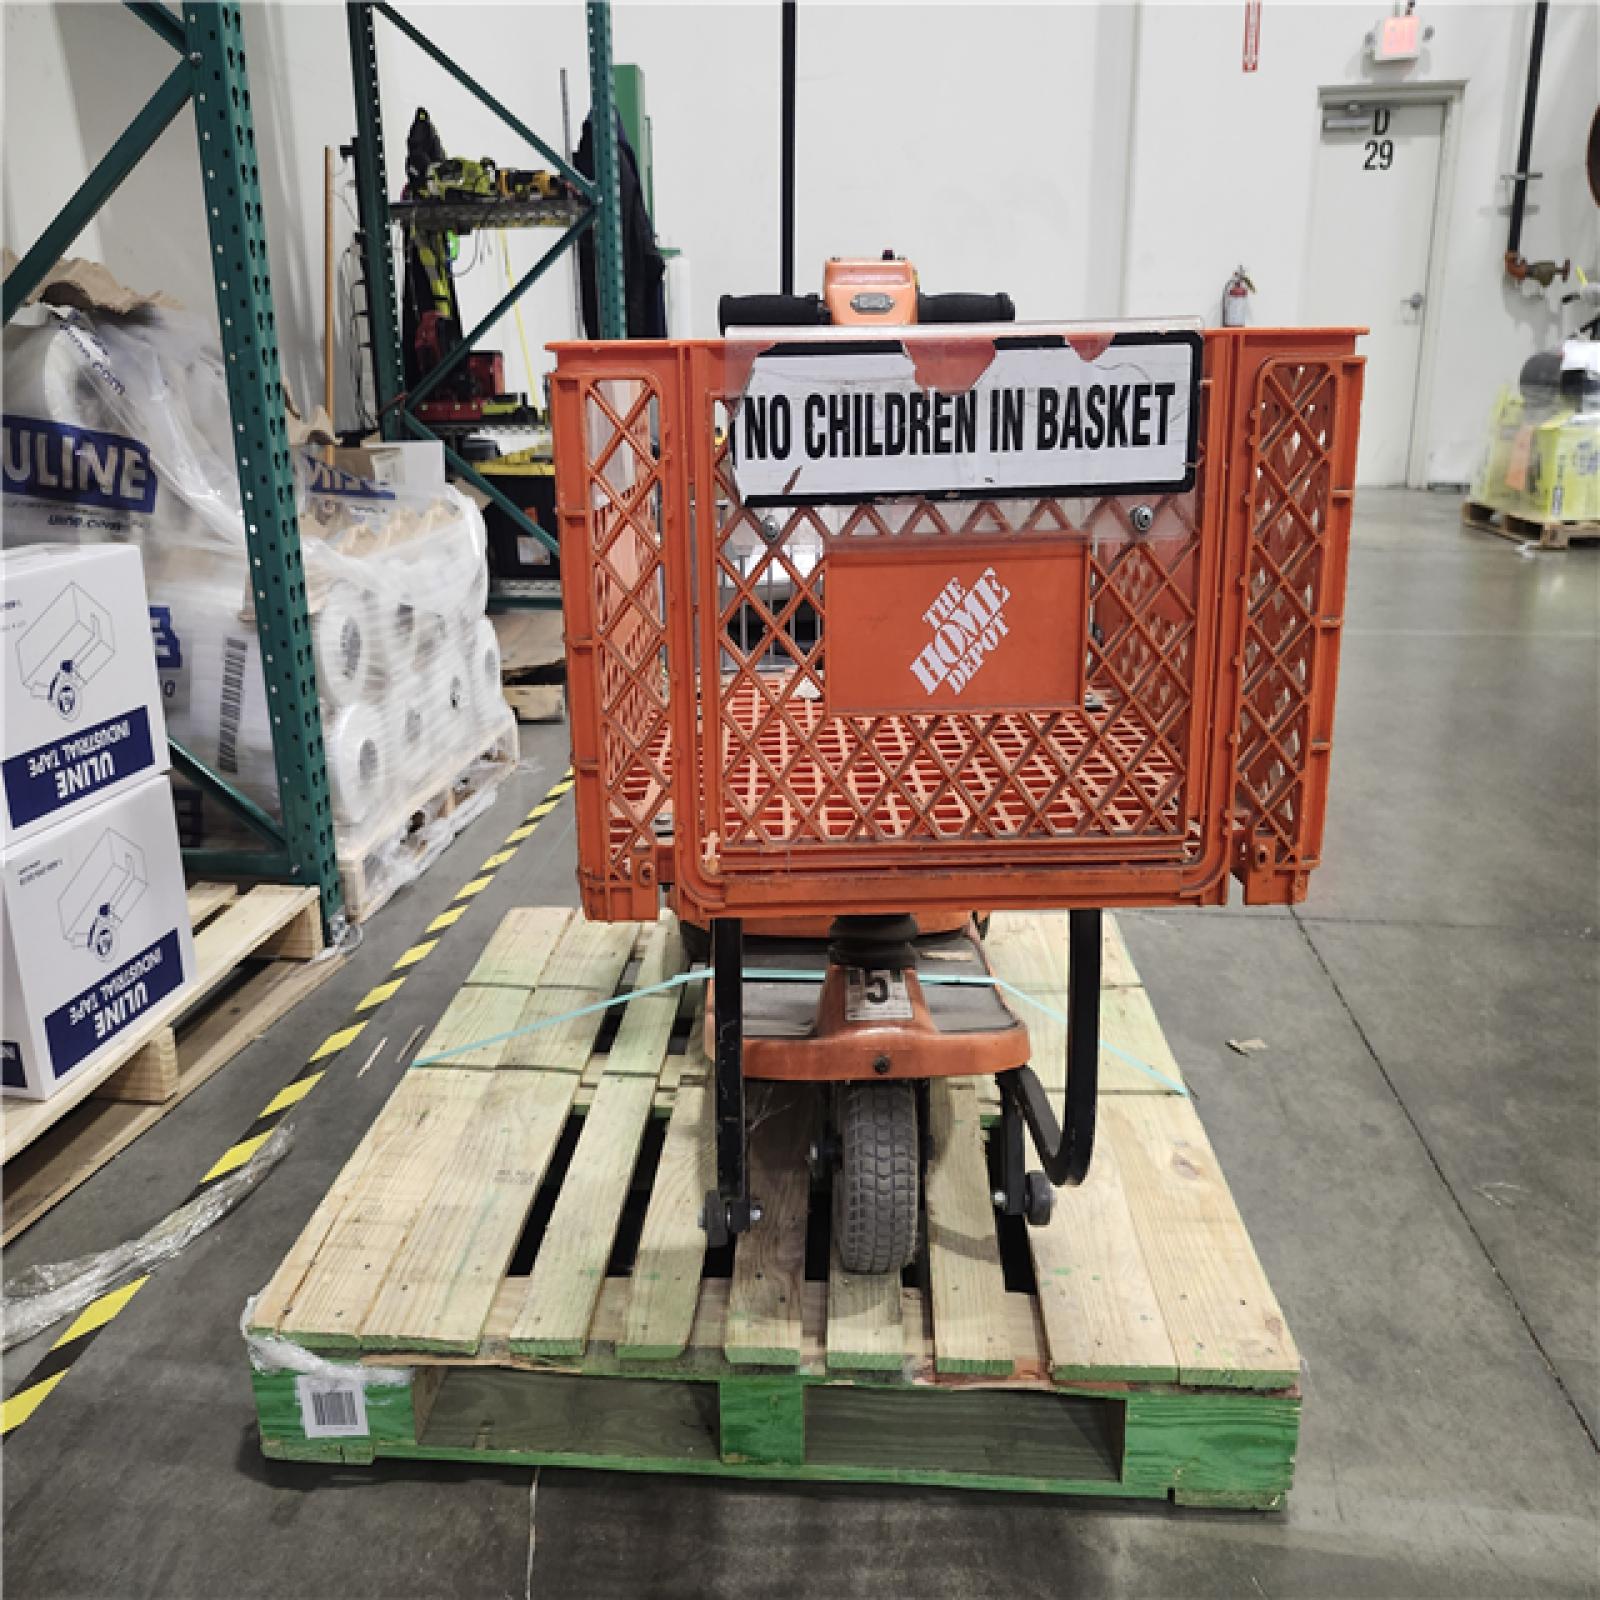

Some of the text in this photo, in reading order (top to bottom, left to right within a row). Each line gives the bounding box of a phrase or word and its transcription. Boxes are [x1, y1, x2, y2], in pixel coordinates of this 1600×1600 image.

[1364, 139, 1393, 170] 29
[745, 382, 1176, 460] NO CHILDREN IN BASKET
[2, 427, 147, 500] ULINE
[910, 566, 1011, 695] HOME
[922, 576, 966, 630] THE
[946, 612, 1009, 695] DEPOT
[27, 749, 61, 778] TAPE
[55, 751, 116, 799] ULINE
[69, 991, 99, 1026] TAPE
[94, 981, 148, 1039] ULINE
